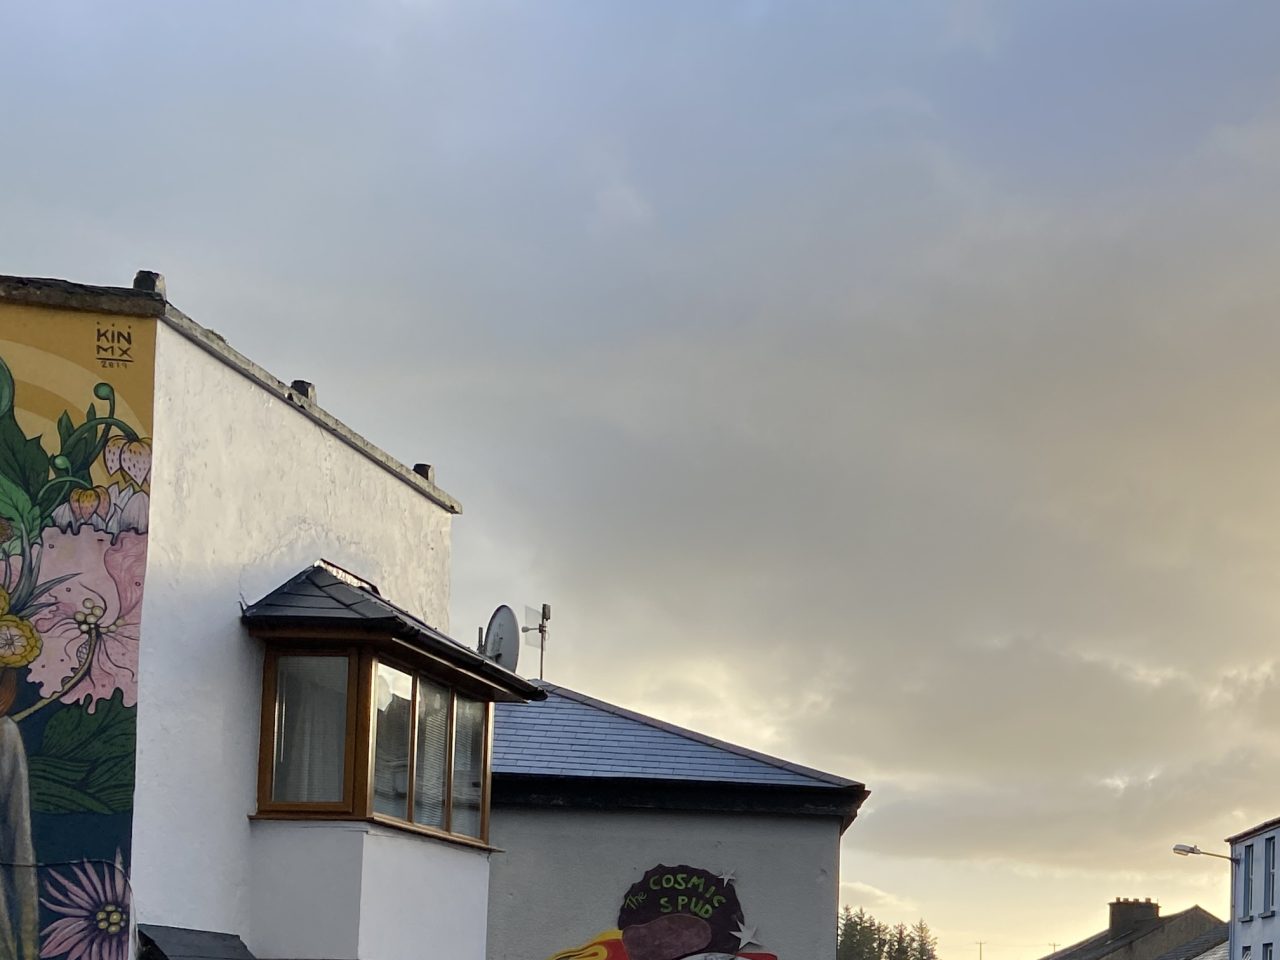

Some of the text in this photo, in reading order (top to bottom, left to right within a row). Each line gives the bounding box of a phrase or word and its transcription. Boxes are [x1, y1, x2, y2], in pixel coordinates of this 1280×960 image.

[97, 325, 132, 345] KIN
[96, 345, 133, 359] MX
[624, 873, 726, 910] The COSMIC
[660, 896, 713, 919] SPUD
